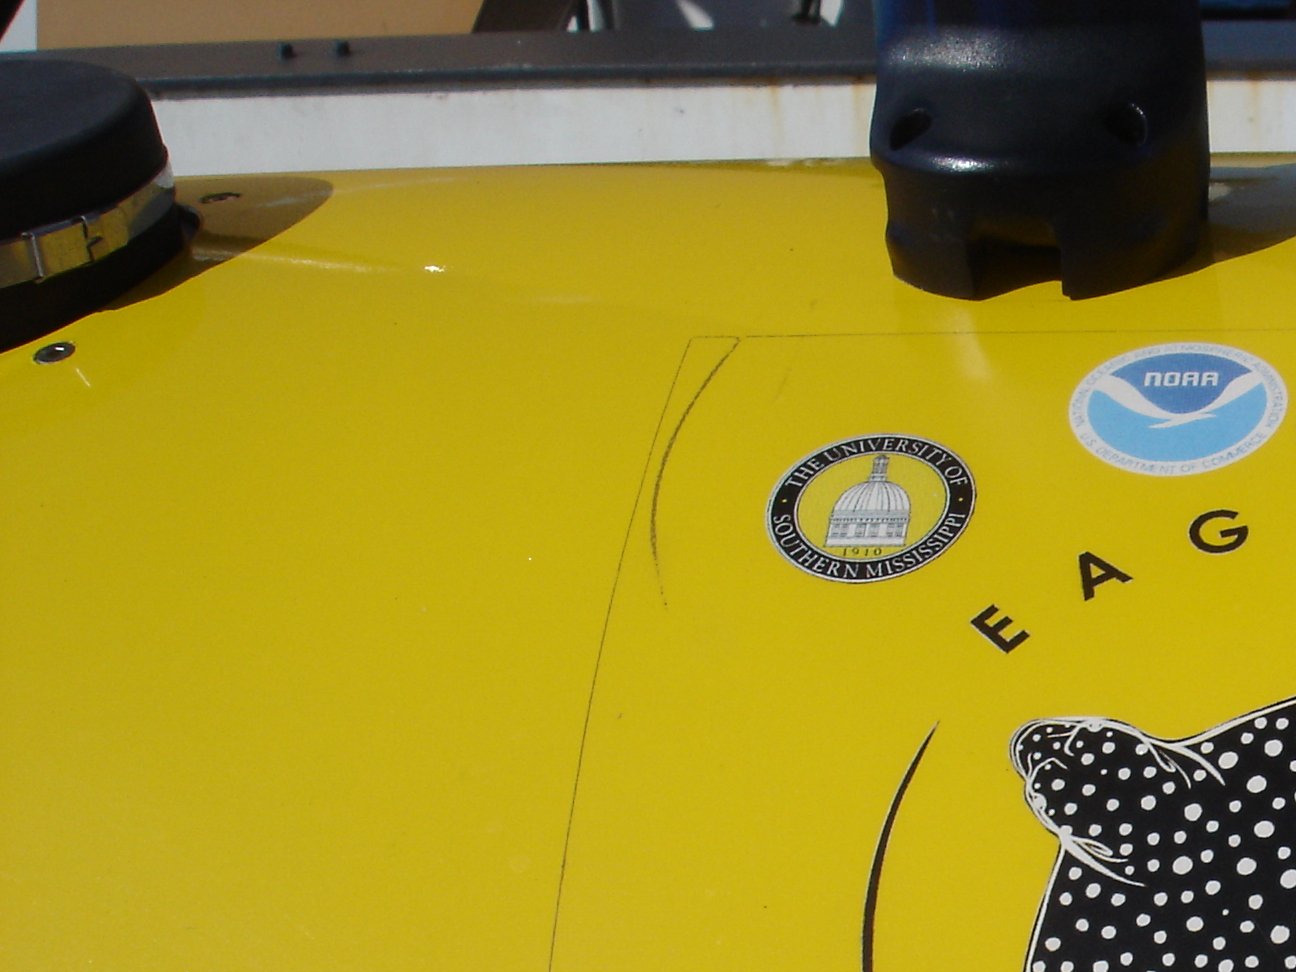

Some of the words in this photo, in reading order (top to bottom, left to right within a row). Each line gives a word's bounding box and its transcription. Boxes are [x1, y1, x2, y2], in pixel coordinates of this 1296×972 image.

[1143, 371, 1219, 387] NOAA
[784, 458, 825, 489] THE
[825, 437, 953, 467] UNIVERSITY
[943, 464, 970, 487] OF
[772, 513, 860, 579] SOUTHERN
[865, 512, 967, 579] MISSISSIPPI
[842, 546, 883, 558] 1910
